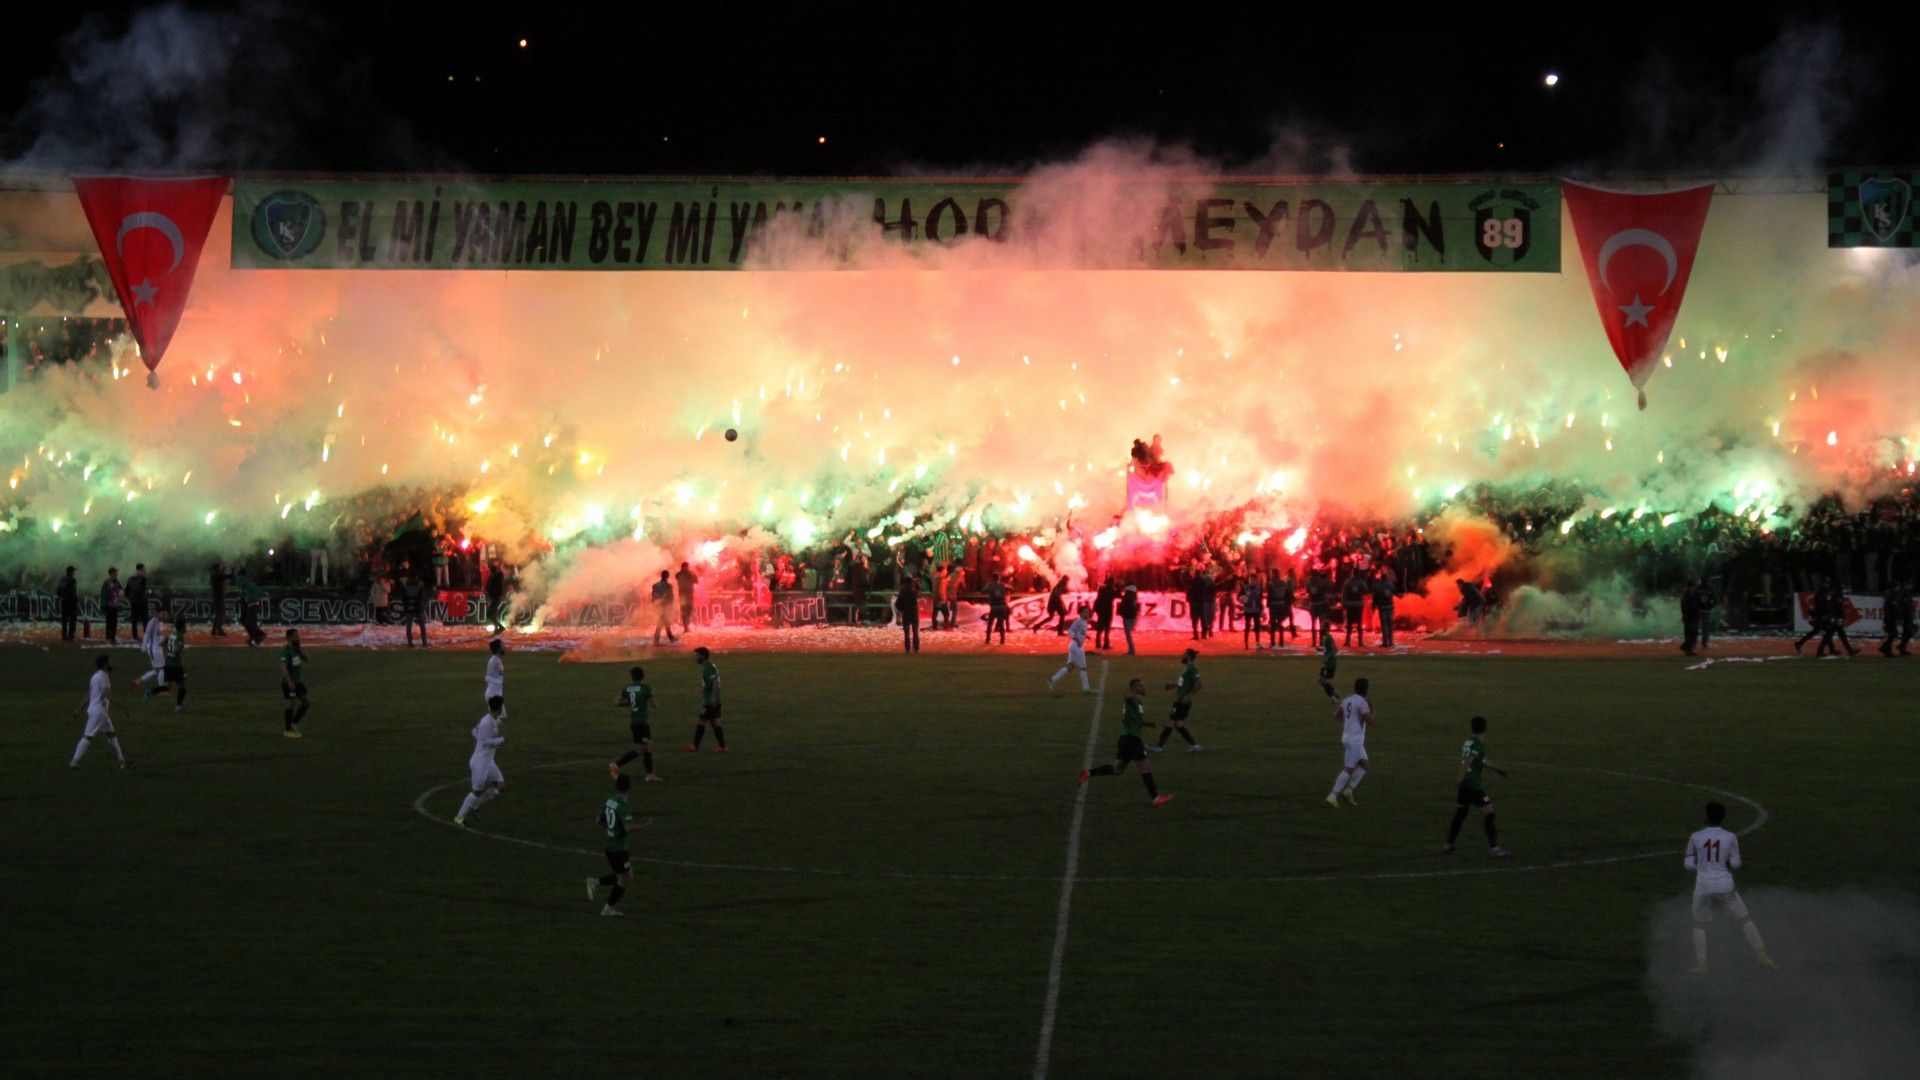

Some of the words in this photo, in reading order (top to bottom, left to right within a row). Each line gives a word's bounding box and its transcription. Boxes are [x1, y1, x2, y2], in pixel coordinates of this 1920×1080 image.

[336, 200, 377, 262] EL
[387, 185, 442, 263] Mİ
[451, 200, 578, 264] YAMAN
[588, 200, 658, 264] BEY
[665, 185, 720, 264] Mİ
[1482, 217, 1524, 249] 89
[1703, 838, 1720, 863] 11
